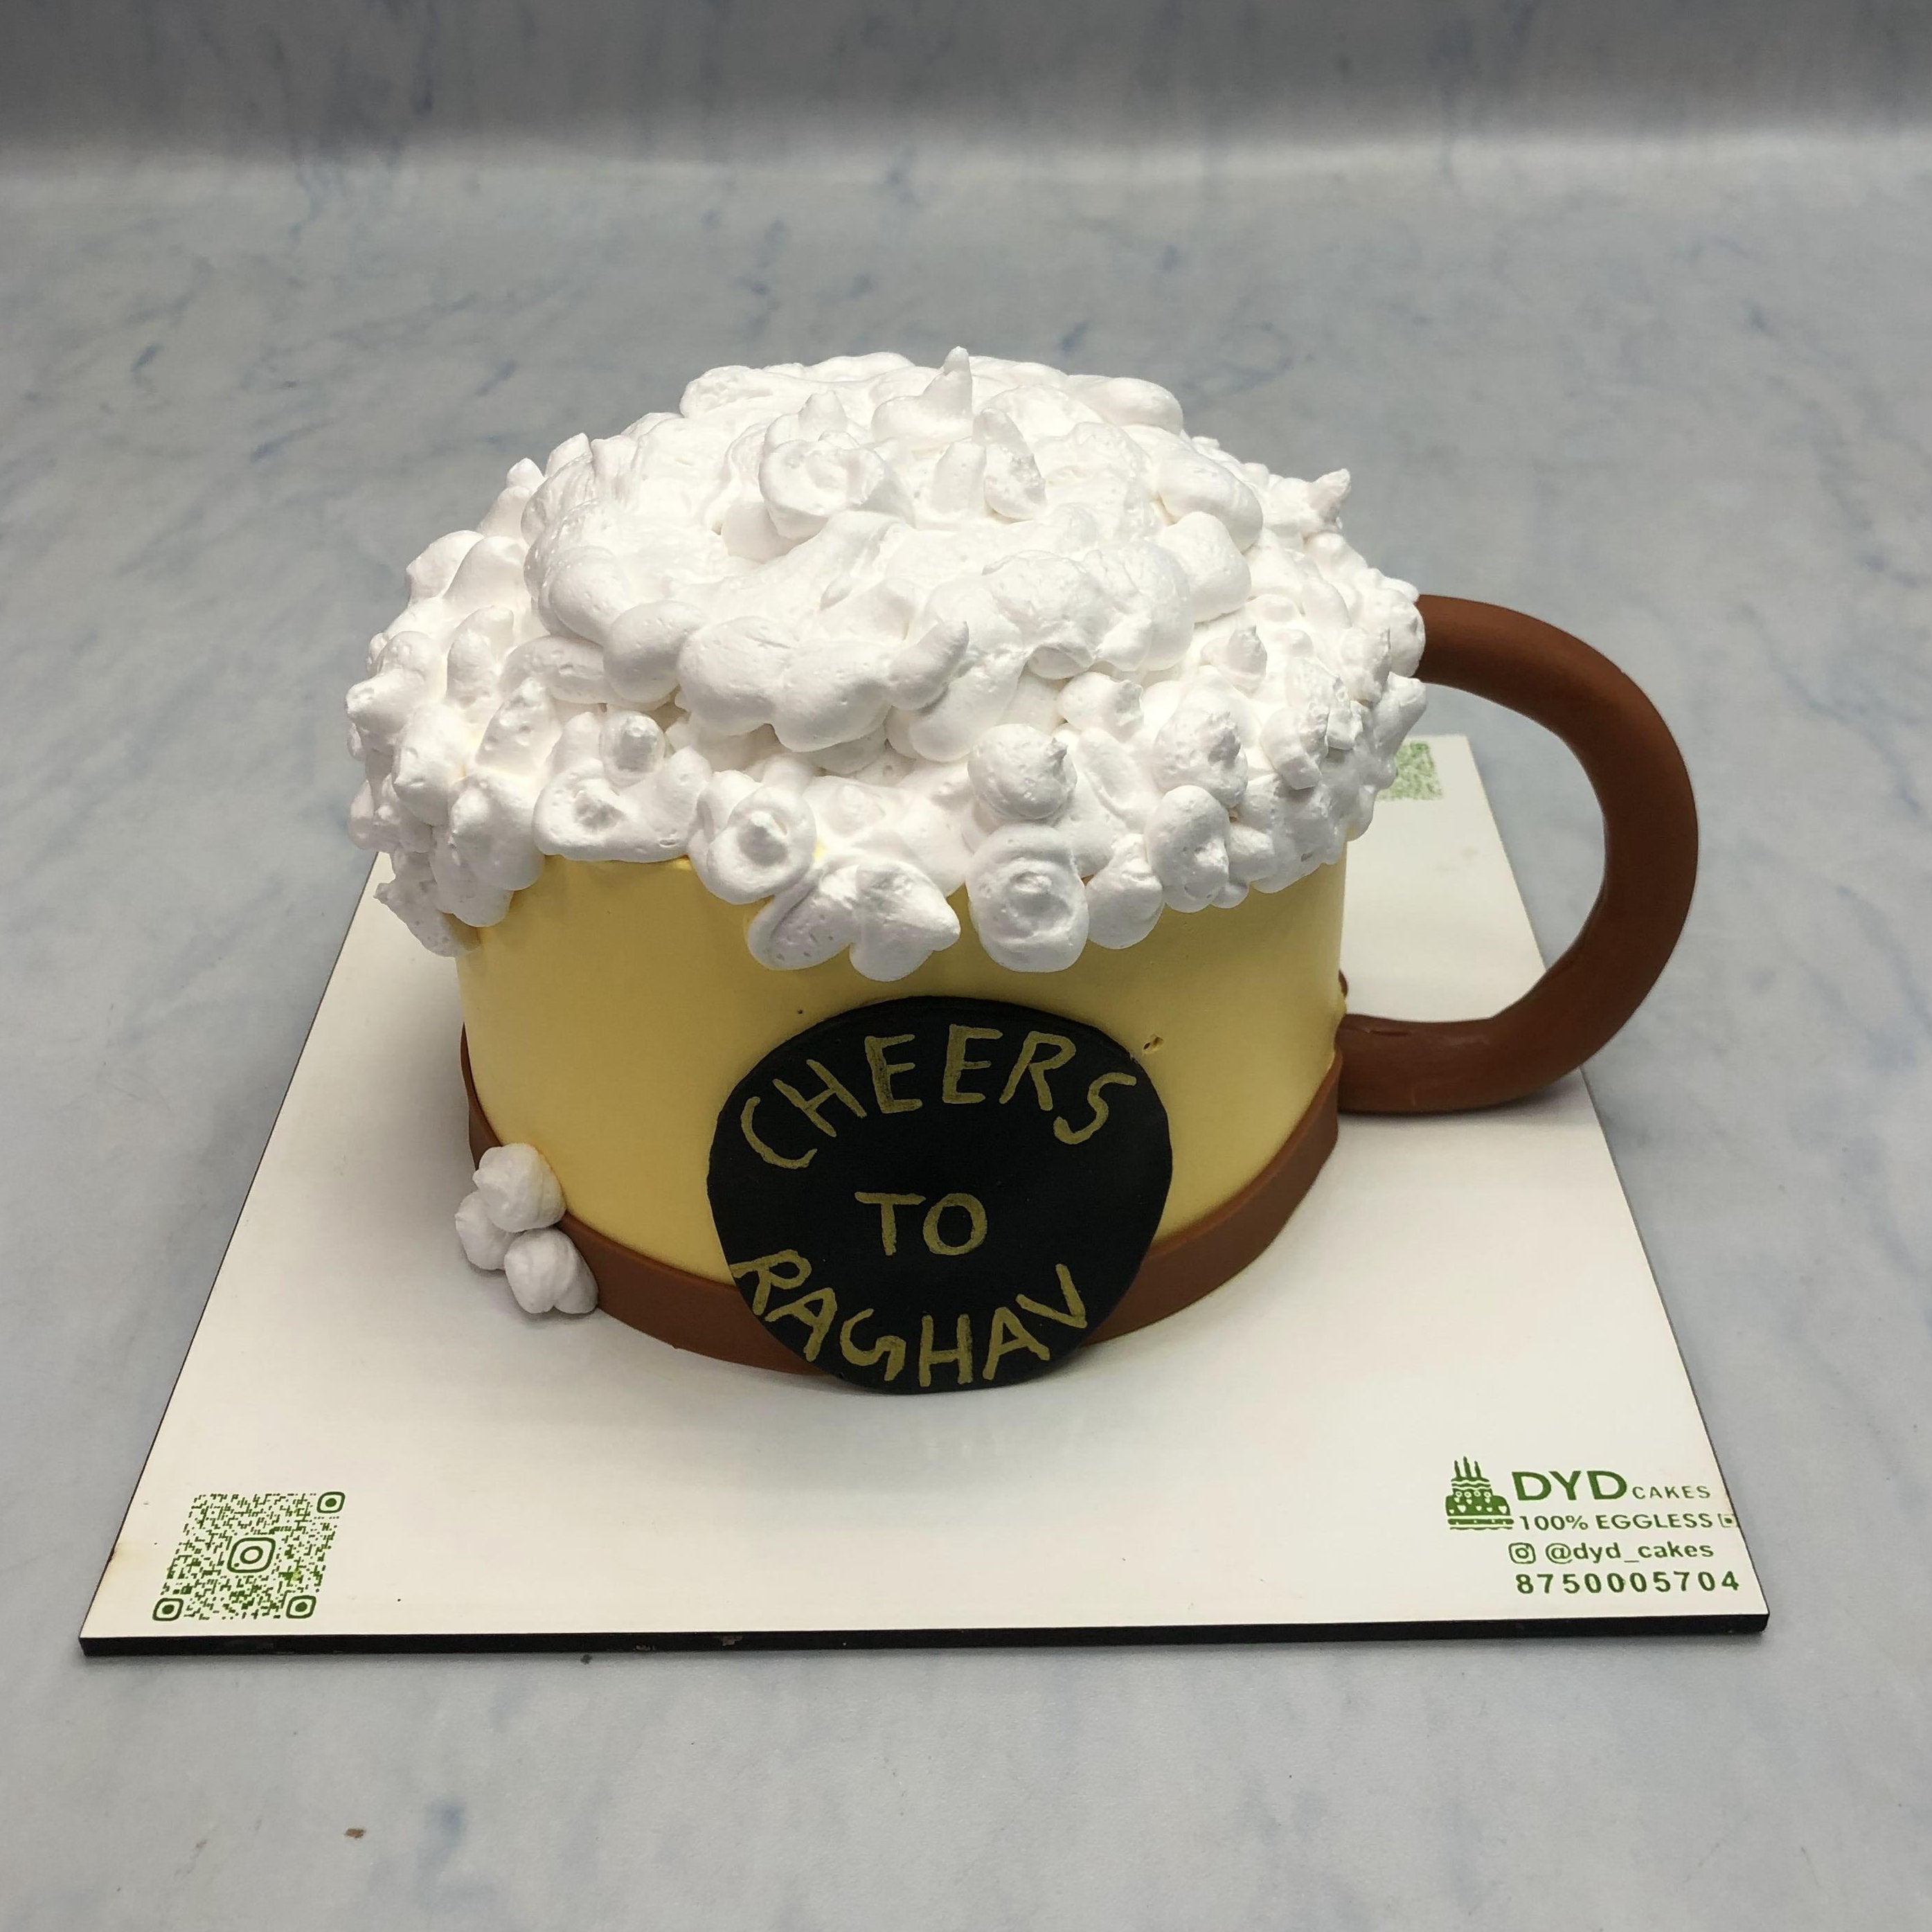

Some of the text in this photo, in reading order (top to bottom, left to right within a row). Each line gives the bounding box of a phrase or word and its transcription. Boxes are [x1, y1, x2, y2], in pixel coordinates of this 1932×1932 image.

[740, 1023, 1137, 1169] CHEERS
[855, 1192, 988, 1255] TO
[728, 1249, 1088, 1387] RAGHAV
[1511, 1470, 1711, 1501] DYD CAKES
[1519, 1513, 1713, 1531] 100% EGGLESS
[1545, 1541, 1714, 1564] @dyd_cakes
[1515, 1571, 1739, 1594] 8750005704
